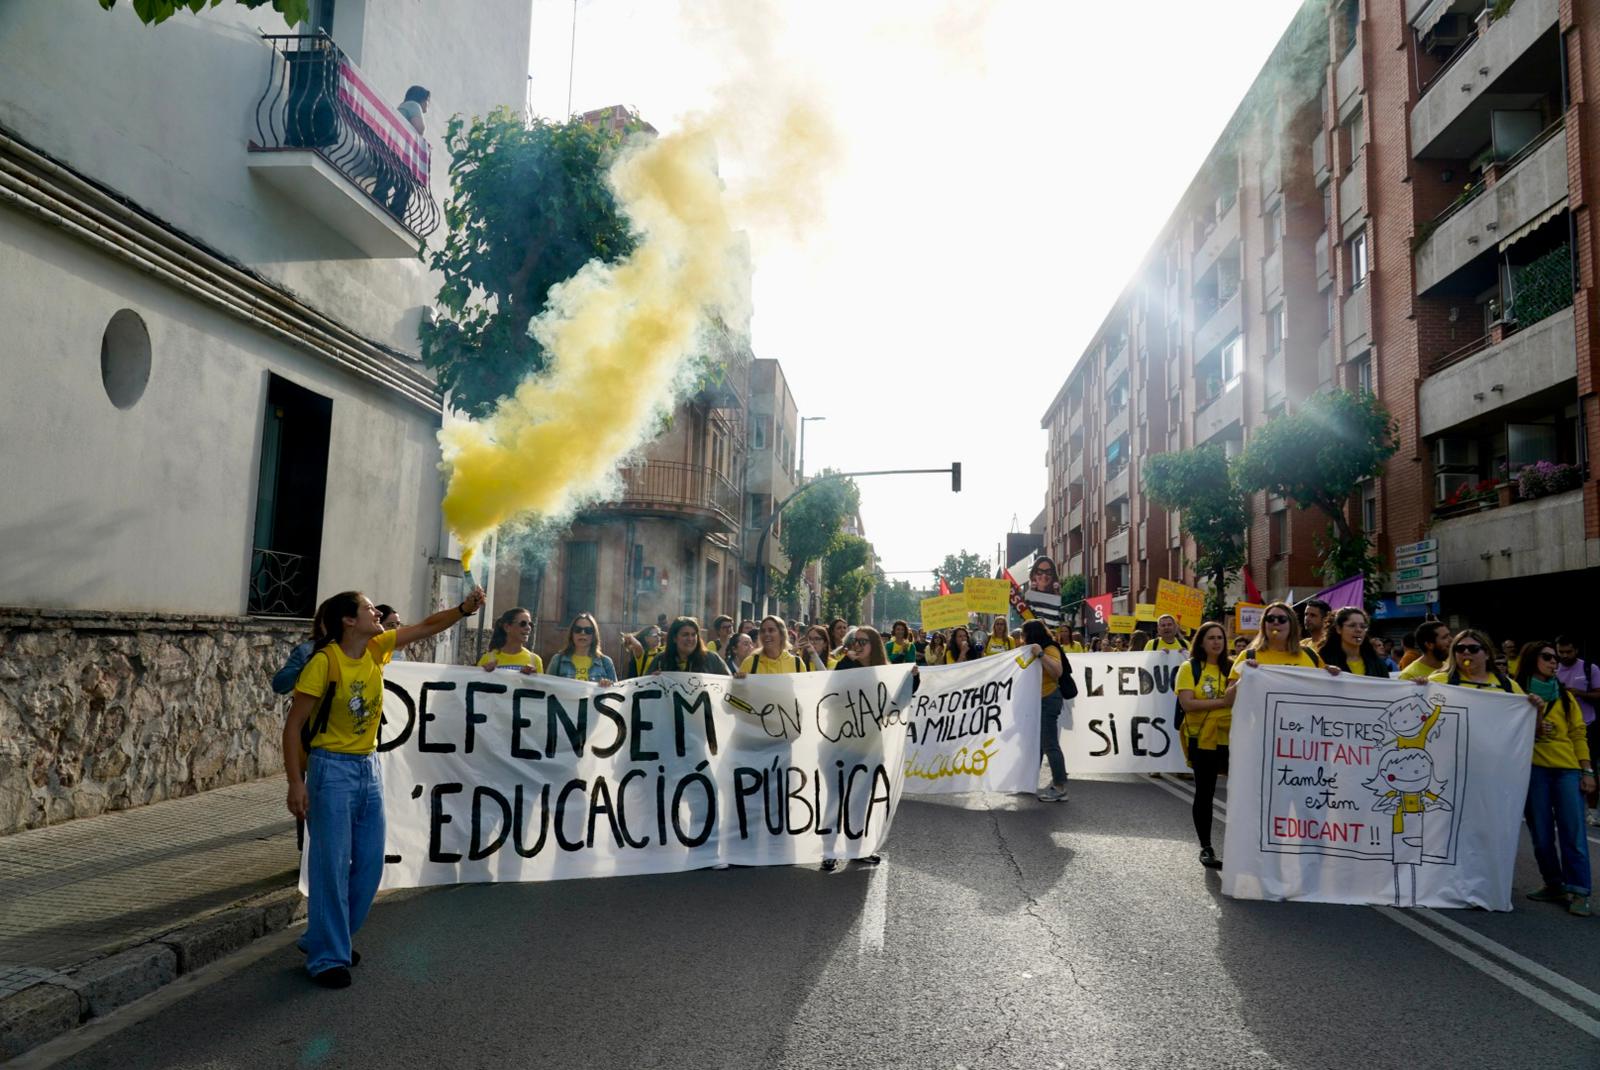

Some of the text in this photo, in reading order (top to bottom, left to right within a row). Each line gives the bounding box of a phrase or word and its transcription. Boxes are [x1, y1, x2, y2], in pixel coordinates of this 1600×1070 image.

[1094, 604, 1104, 625] CGT
[376, 680, 718, 761] DEFENSEM
[920, 704, 1002, 746] MILLOR
[1279, 714, 1386, 742] Les MESTRES
[1130, 716, 1170, 757] ES
[1276, 737, 1376, 766] LLUITANT
[1278, 764, 1339, 789] també
[1305, 788, 1360, 811] estem
[1274, 816, 1365, 843] EDUCANT
